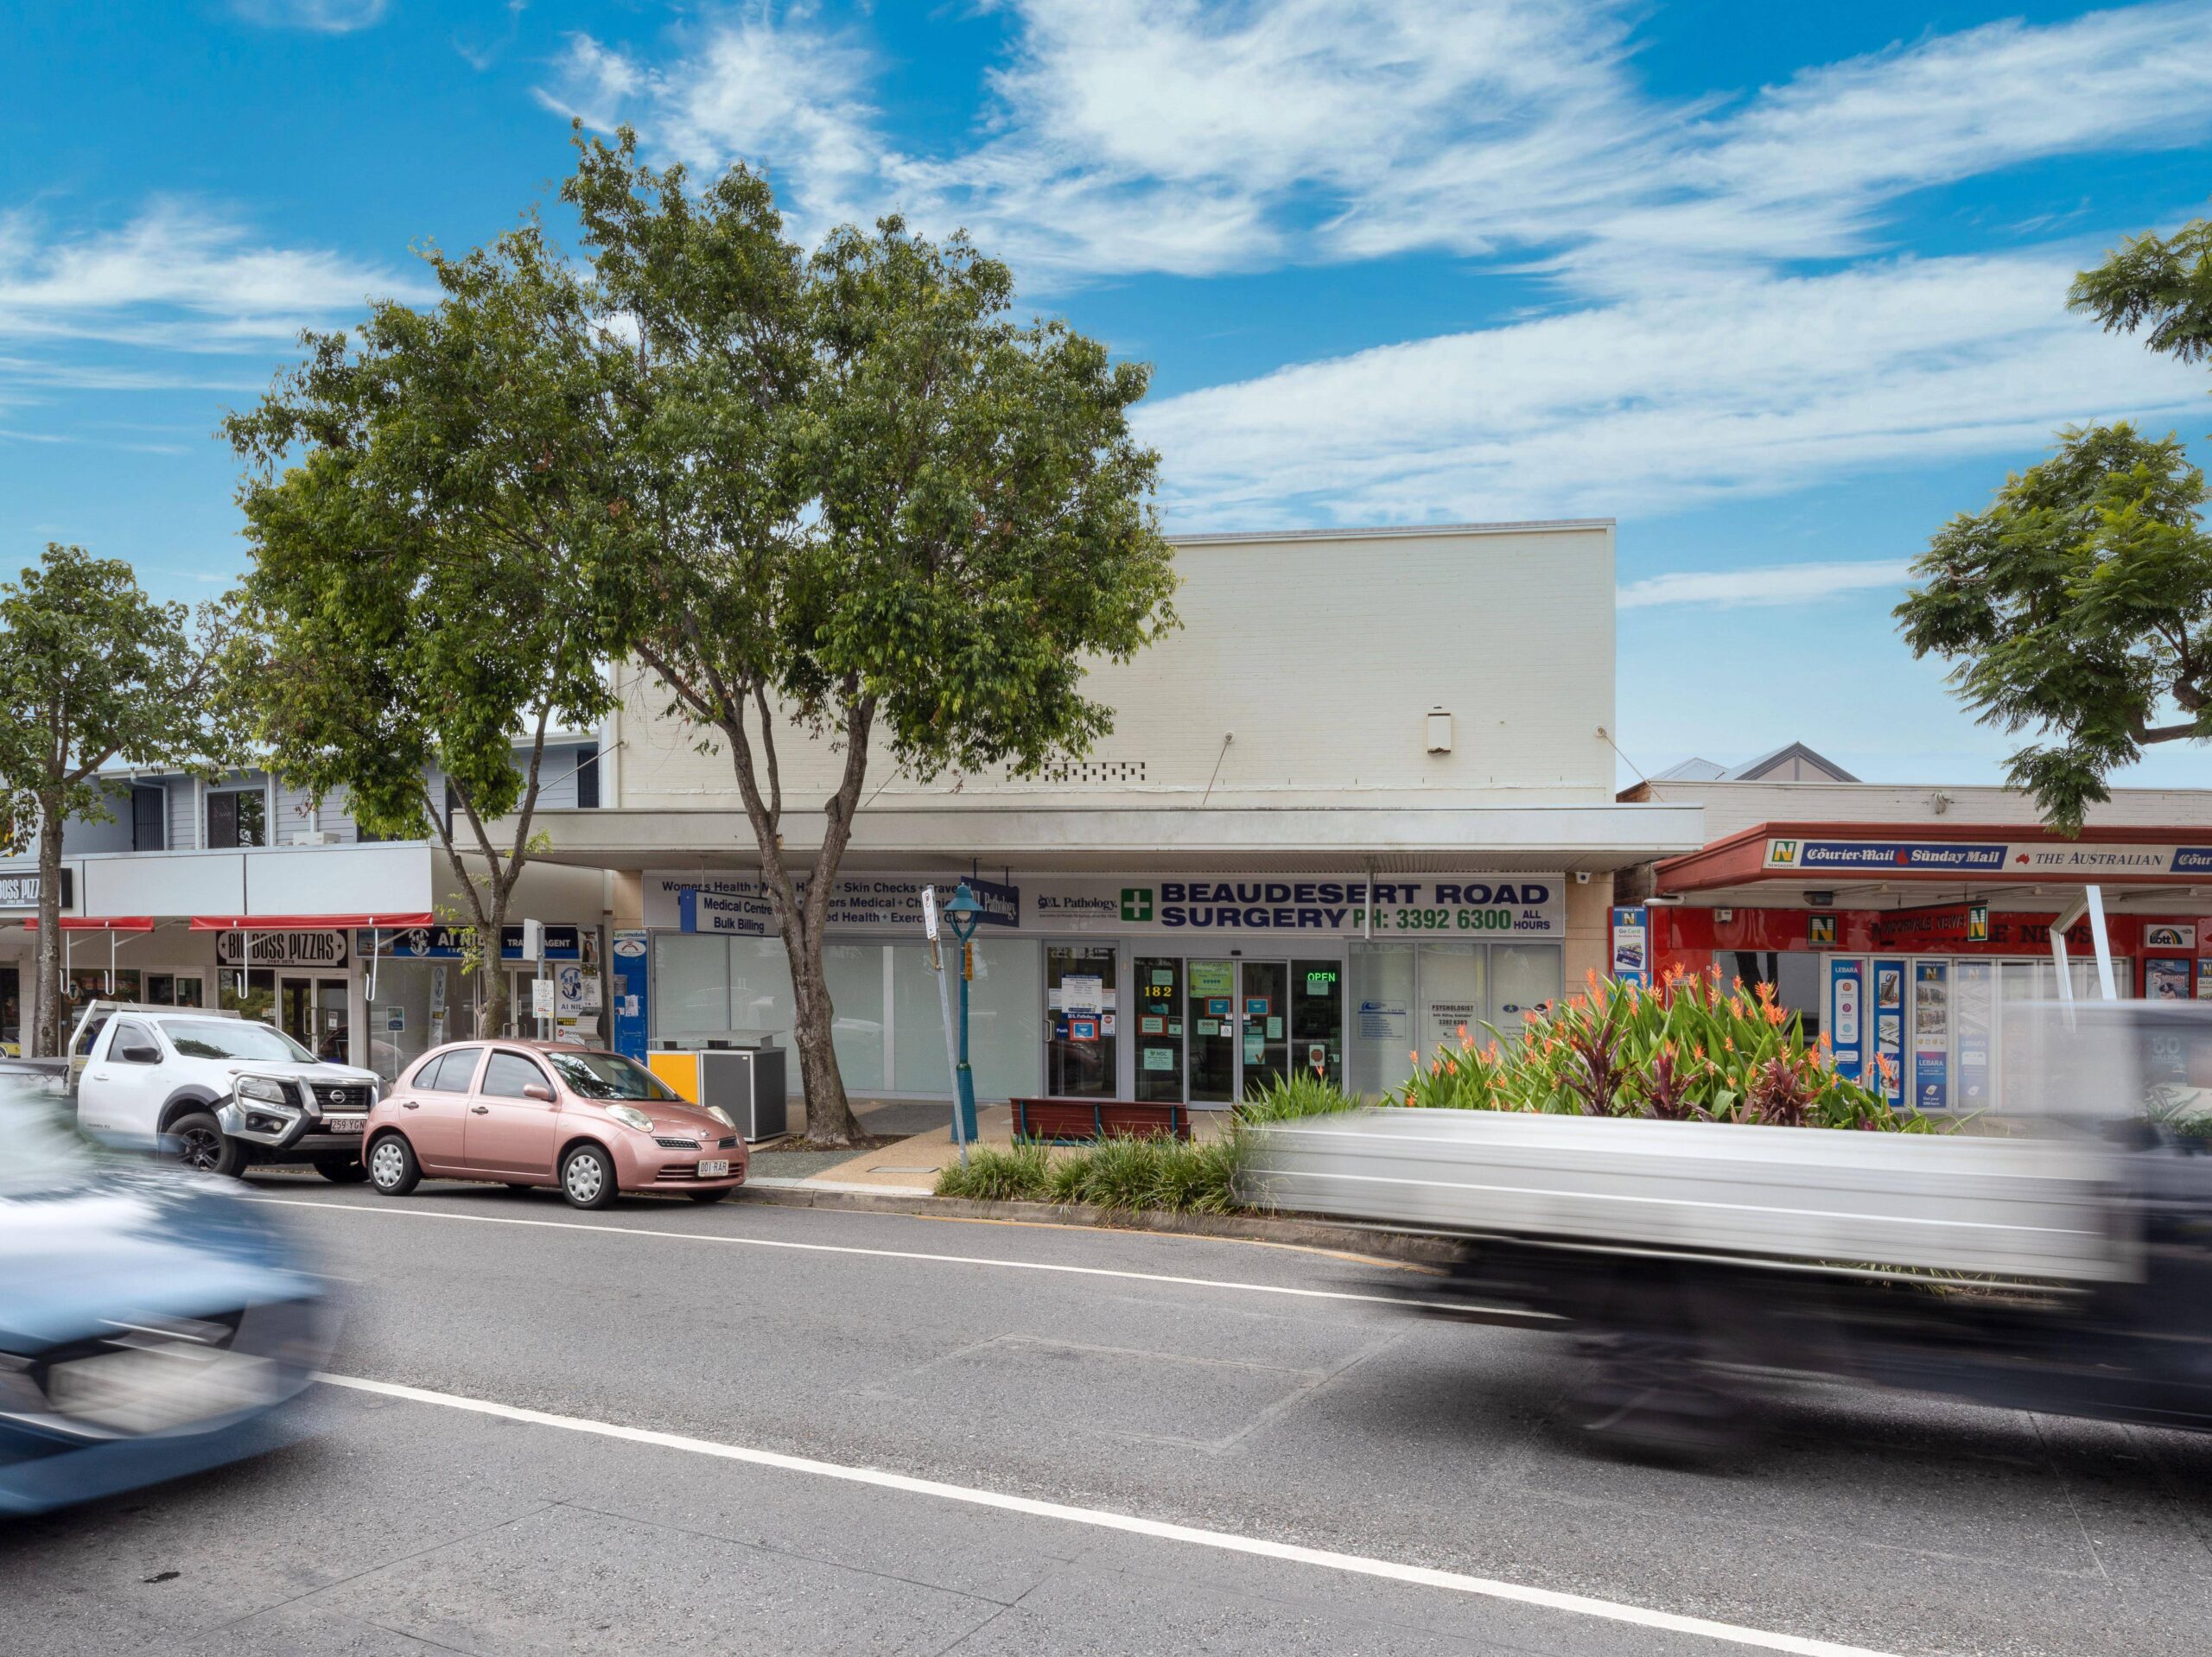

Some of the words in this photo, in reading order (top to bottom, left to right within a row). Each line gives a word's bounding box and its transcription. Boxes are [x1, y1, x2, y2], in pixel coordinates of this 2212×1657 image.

[1807, 848, 1895, 861] Courier-Mail
[1910, 849, 1966, 864] Sunday
[1966, 851, 2000, 863] Mail
[2035, 853, 2065, 864] THE
[2069, 852, 2164, 866] AUSTRALIAN
[22, 879, 40, 899] PIZZ
[715, 881, 751, 892] Health
[844, 882, 869, 893] Skin
[877, 882, 916, 893] Checks
[927, 882, 958, 893] rave
[1160, 883, 1421, 905] BEAUDESERT
[1435, 883, 1549, 905] ROAD
[703, 897, 742, 911] Medical
[744, 901, 772, 916] Centre
[850, 897, 895, 908] Medical
[842, 911, 880, 923] Health
[1160, 907, 1348, 928] SURGERY
[1396, 908, 1450, 930] 3392
[1457, 908, 1511, 930] 6300
[1522, 910, 1541, 919] ALL
[714, 916, 735, 929] Bulk
[738, 918, 765, 934] Billing
[1513, 920, 1551, 930] HOURS
[460, 932, 486, 947] NIL
[507, 938, 524, 947] TRA
[544, 939, 570, 948] AGENT
[252, 933, 285, 960] BOSS
[289, 933, 334, 961] PIZZAS
[1307, 972, 1336, 982] OPEN
[1144, 986, 1173, 997] 182
[332, 1121, 346, 1129] 259
